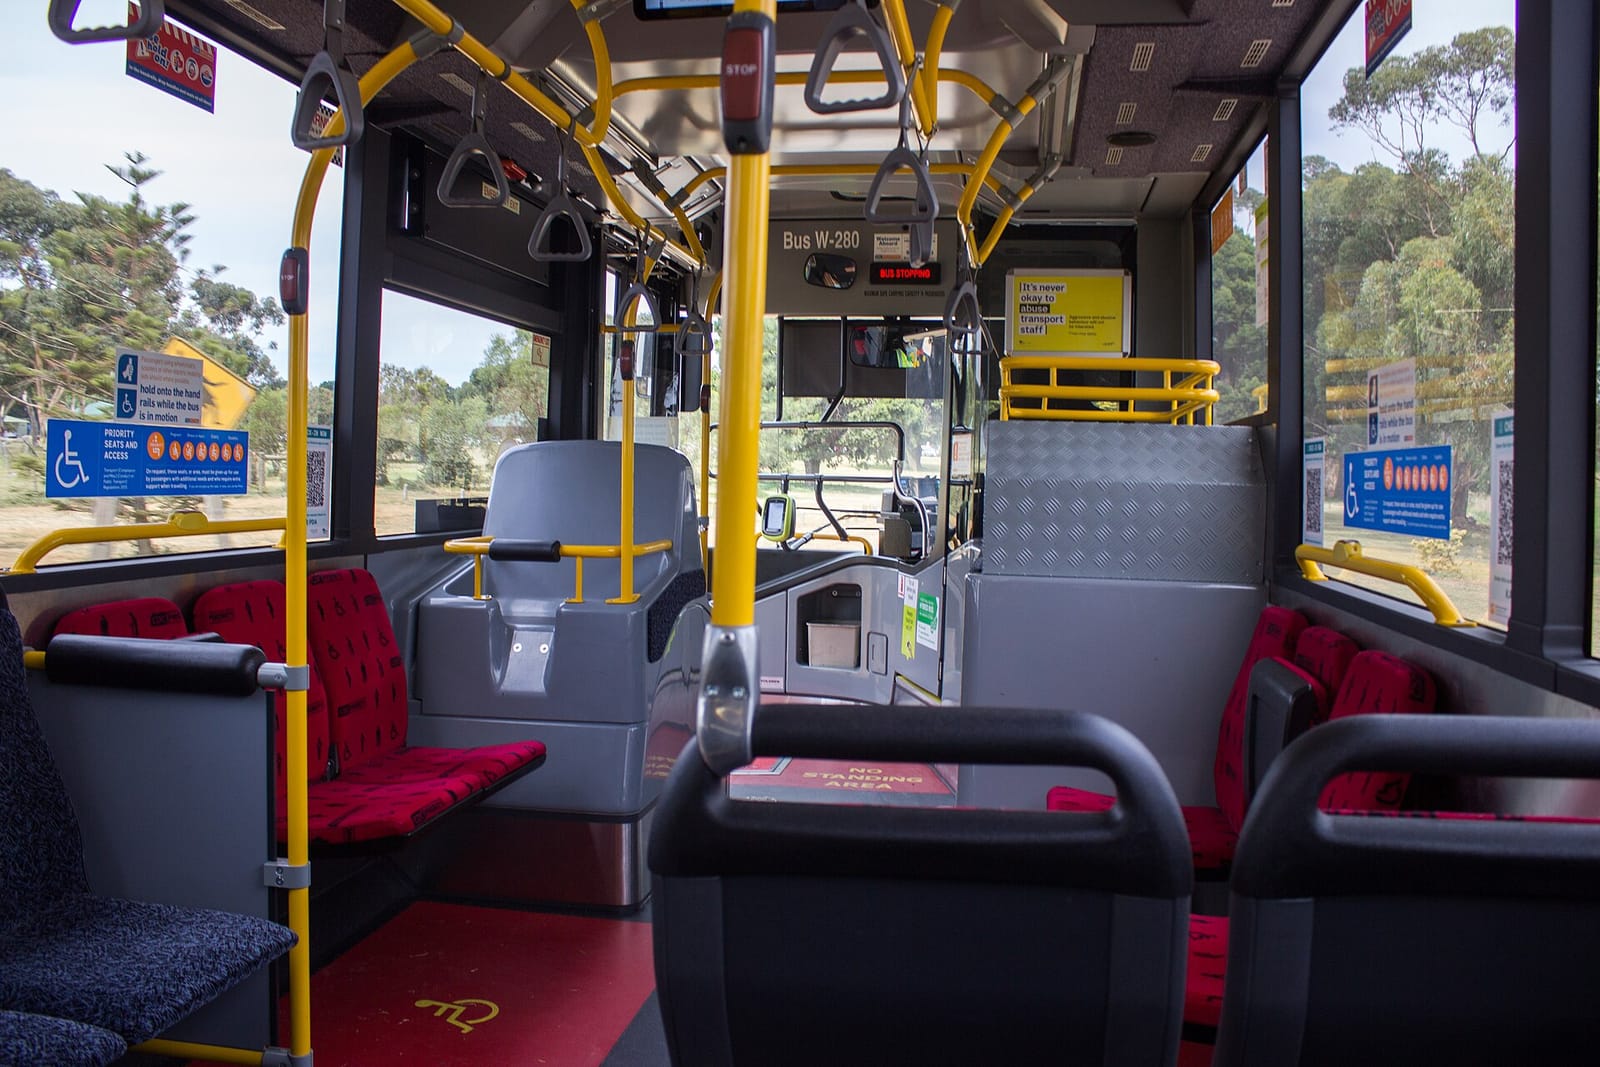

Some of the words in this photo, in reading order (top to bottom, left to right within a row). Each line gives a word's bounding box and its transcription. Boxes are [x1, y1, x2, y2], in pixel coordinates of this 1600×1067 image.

[147, 39, 168, 57] hold
[154, 54, 170, 70] on!
[726, 64, 758, 76] STOP
[783, 231, 811, 249] Bus
[815, 230, 860, 249] W-280
[880, 268, 895, 278] BUS
[896, 268, 931, 278] STOPPING
[1022, 283, 1038, 292] It's
[1040, 284, 1065, 292] never
[1020, 294, 1043, 304] okay
[1045, 294, 1055, 303] to
[1020, 304, 1049, 313] abuse
[1020, 315, 1064, 325] transport
[1020, 325, 1043, 334] staff
[140, 384, 156, 395] hold
[156, 387, 172, 396] onto
[173, 386, 184, 397] the
[185, 387, 201, 399] hand
[140, 398, 156, 408] rails
[157, 400, 175, 409] while
[176, 401, 187, 410] the
[188, 401, 200, 411] bus
[140, 411, 146, 420] is
[147, 412, 154, 420] in
[155, 413, 178, 422] motion
[104, 428, 135, 438] PRIORITY
[104, 440, 124, 449] SEATS
[125, 441, 139, 449] AND
[104, 451, 129, 460] ACCESS
[802, 772, 923, 783] STANDING
[825, 781, 892, 790] AREA
